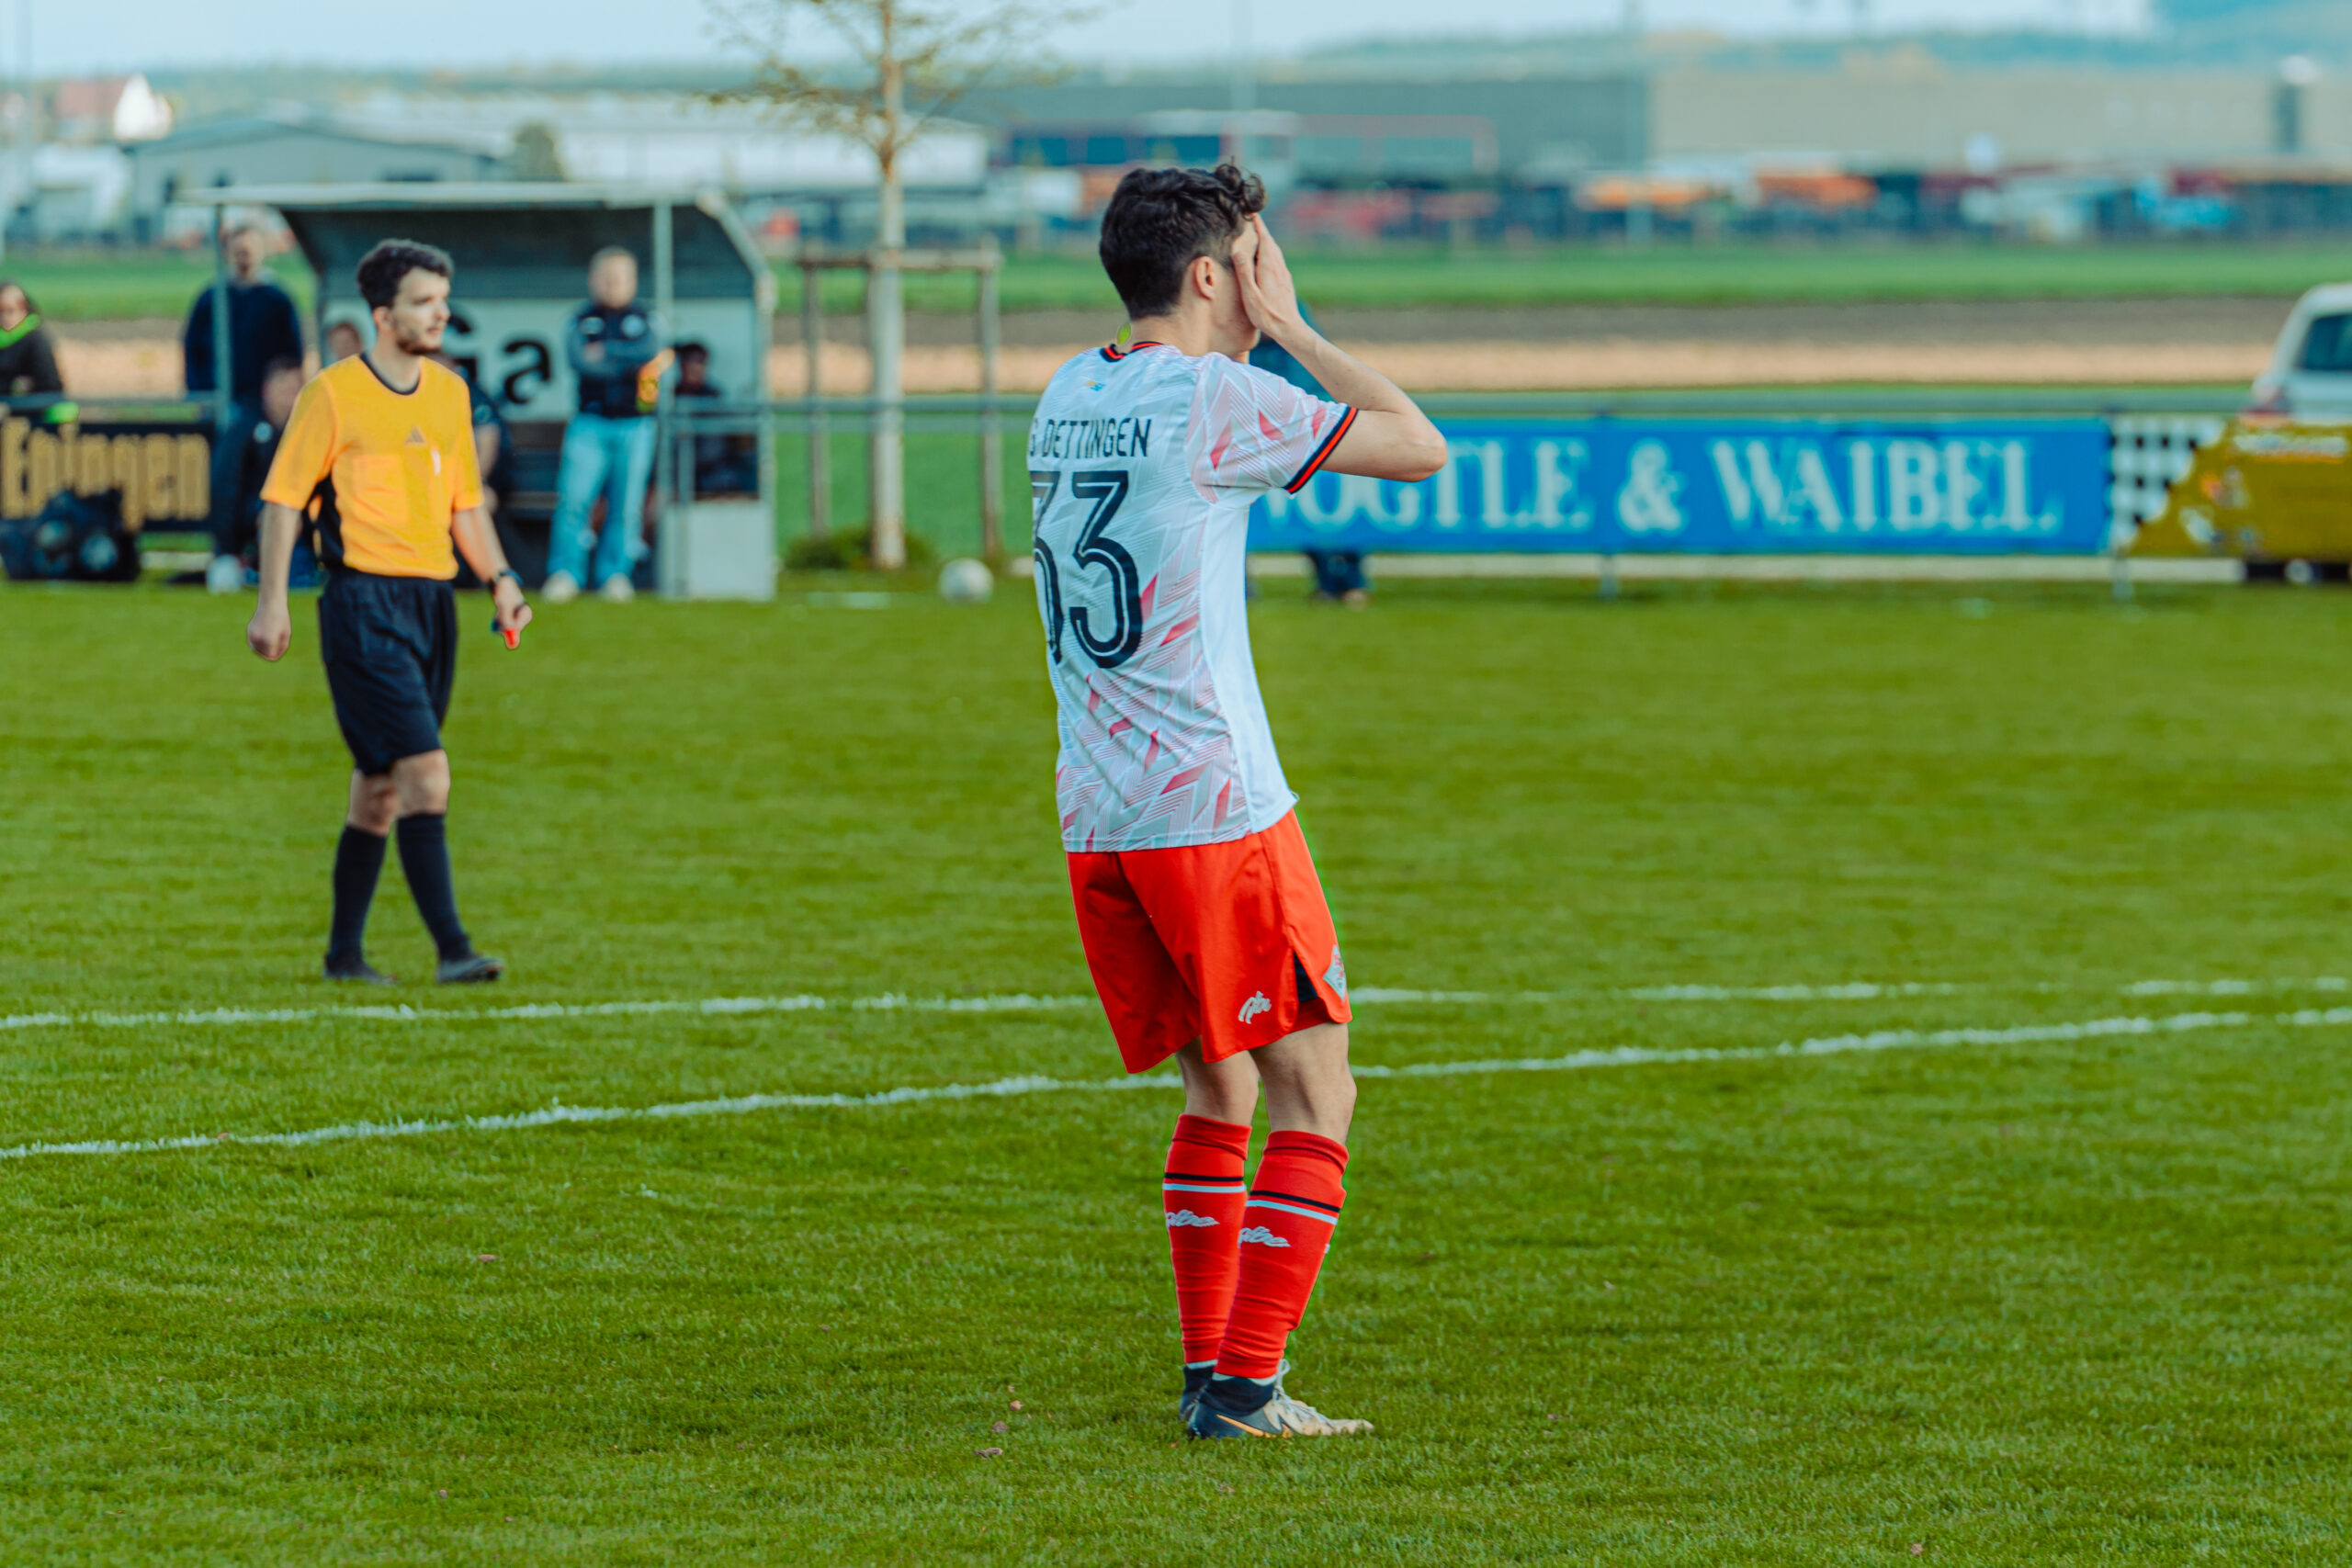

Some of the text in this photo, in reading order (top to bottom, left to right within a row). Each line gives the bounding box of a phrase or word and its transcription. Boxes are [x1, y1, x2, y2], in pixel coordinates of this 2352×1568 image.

[1042, 417, 1153, 459] DETTINGEN
[1617, 437, 1685, 536] &
[1711, 438, 2061, 534] WAIBEL
[1030, 470, 1143, 669] 33
